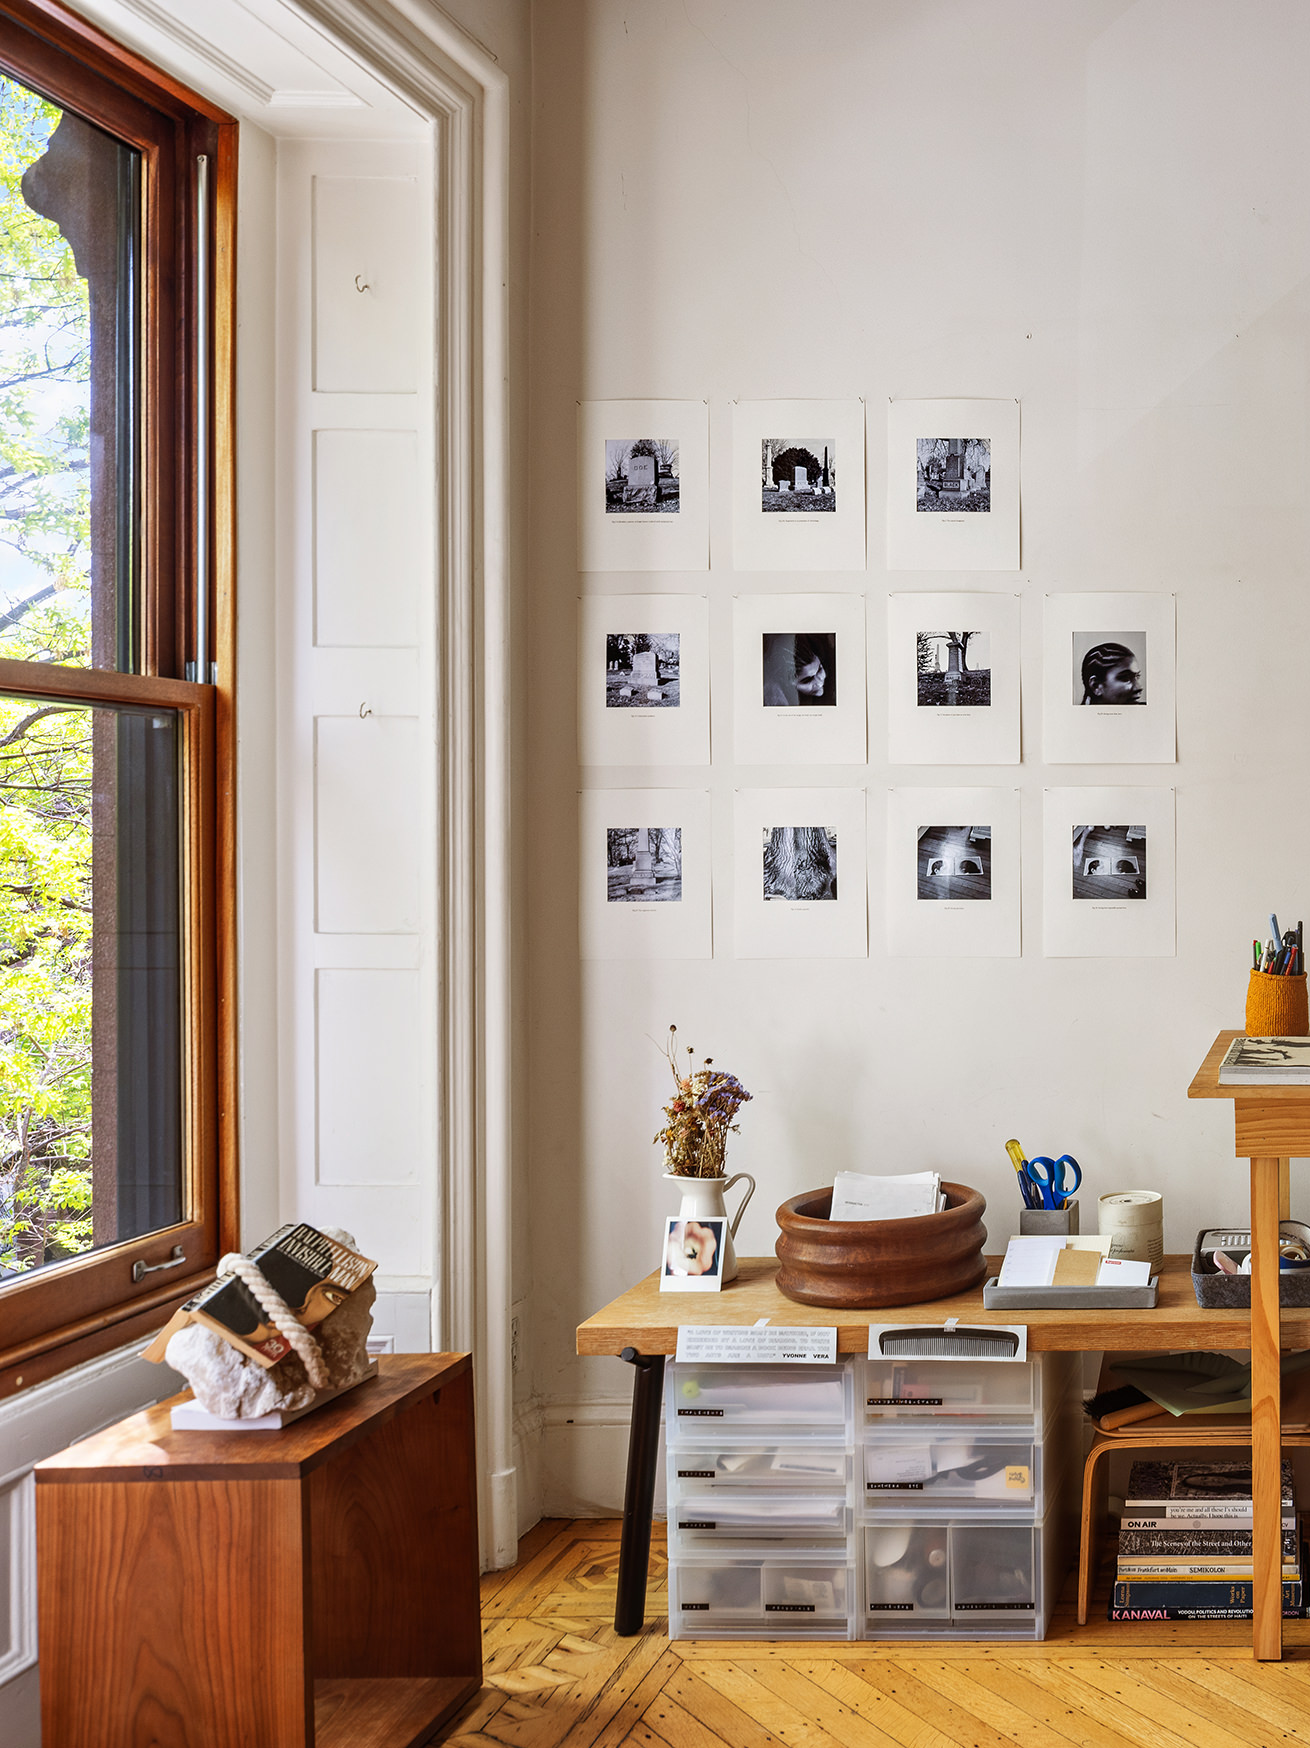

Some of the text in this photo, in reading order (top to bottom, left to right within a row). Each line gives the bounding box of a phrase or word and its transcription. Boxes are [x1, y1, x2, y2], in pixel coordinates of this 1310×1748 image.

[279, 1237, 333, 1274] INVISIBLE
[327, 1266, 360, 1291] MAN
[1235, 1590, 1240, 1599] on
[1112, 1609, 1171, 1620] KANAVAL
